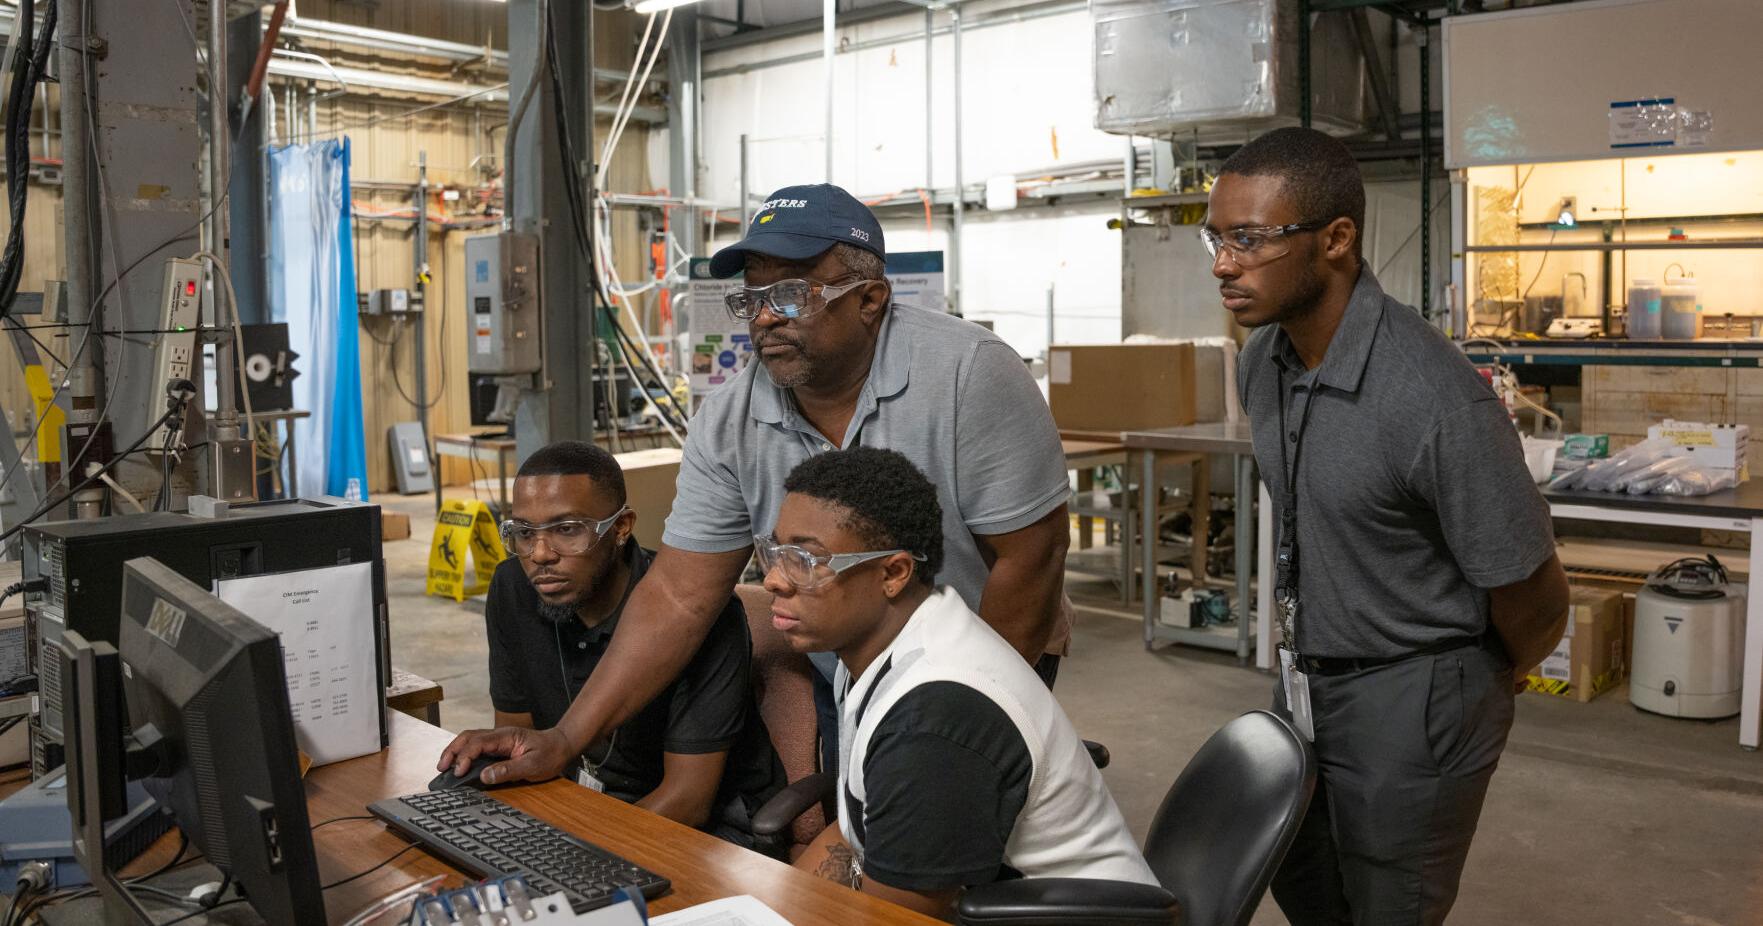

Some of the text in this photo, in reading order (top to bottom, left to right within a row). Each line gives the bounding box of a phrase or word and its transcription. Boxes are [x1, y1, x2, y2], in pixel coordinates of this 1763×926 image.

[762, 199, 807, 210] STERS
[851, 228, 869, 241] 2023
[443, 512, 471, 527] CAUTION
